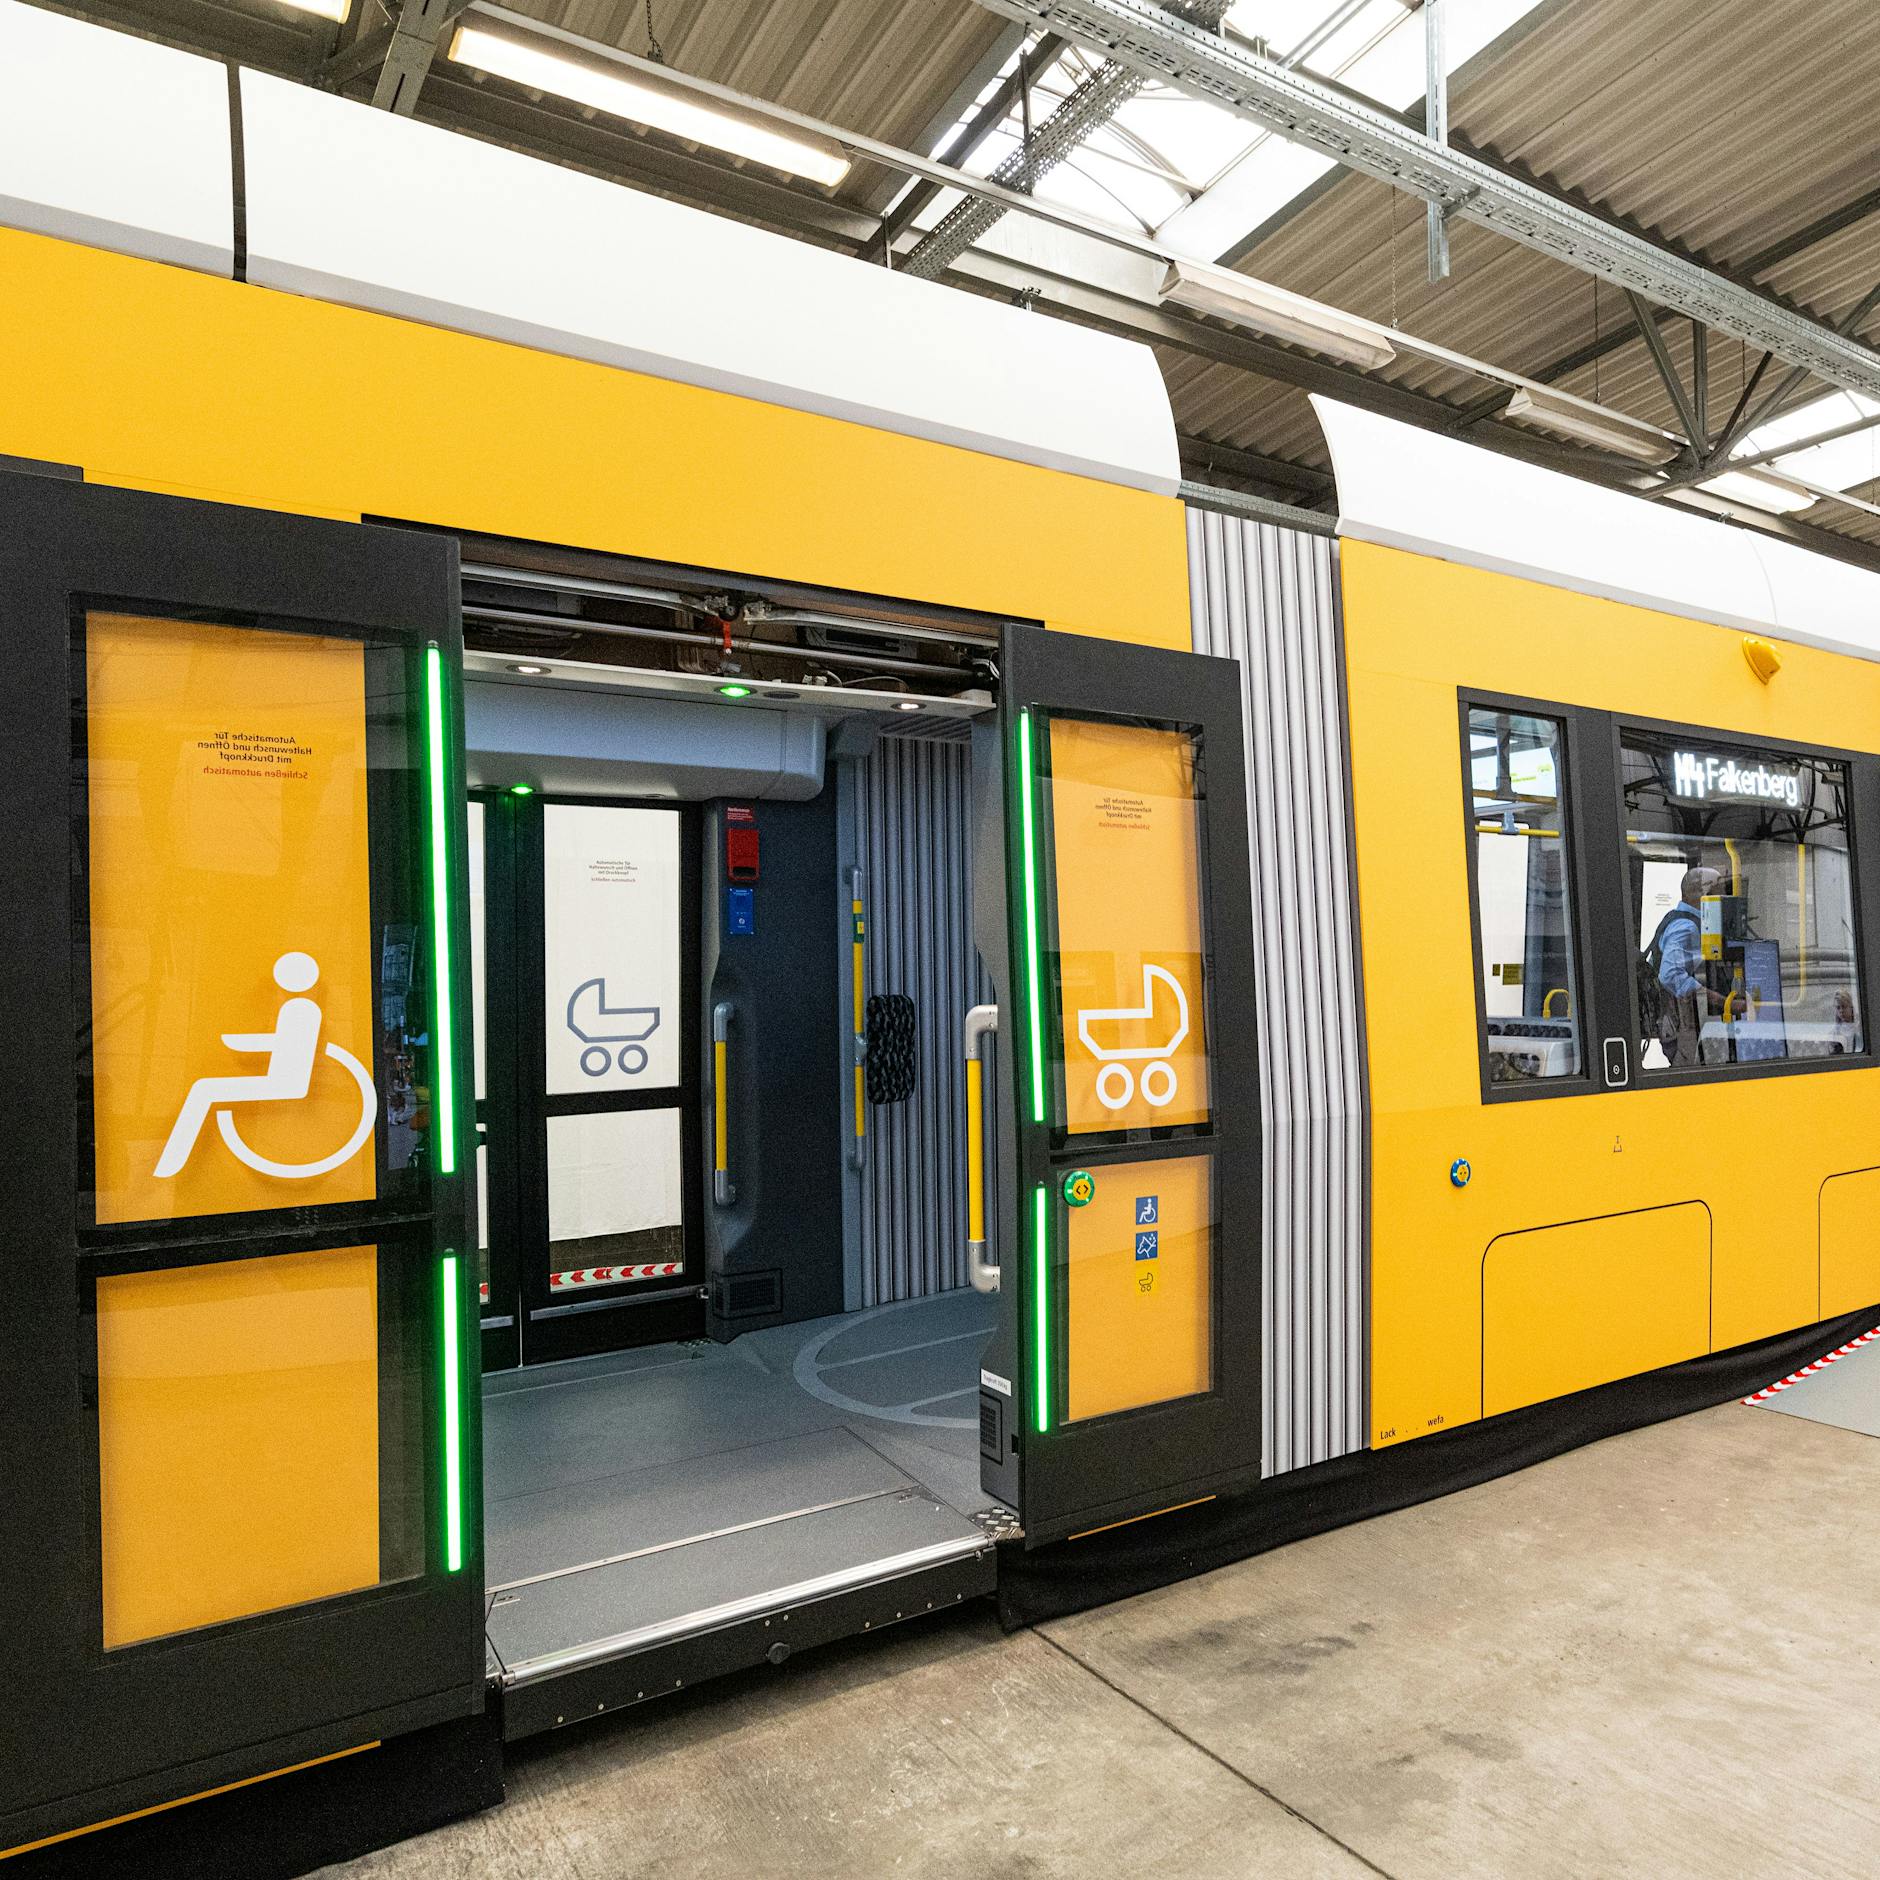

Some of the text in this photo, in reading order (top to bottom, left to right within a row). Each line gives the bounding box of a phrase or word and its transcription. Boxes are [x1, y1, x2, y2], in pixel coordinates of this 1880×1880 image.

[1705, 757, 1798, 807] Falkenberg
[1380, 1415, 1444, 1440] Lack wefa
